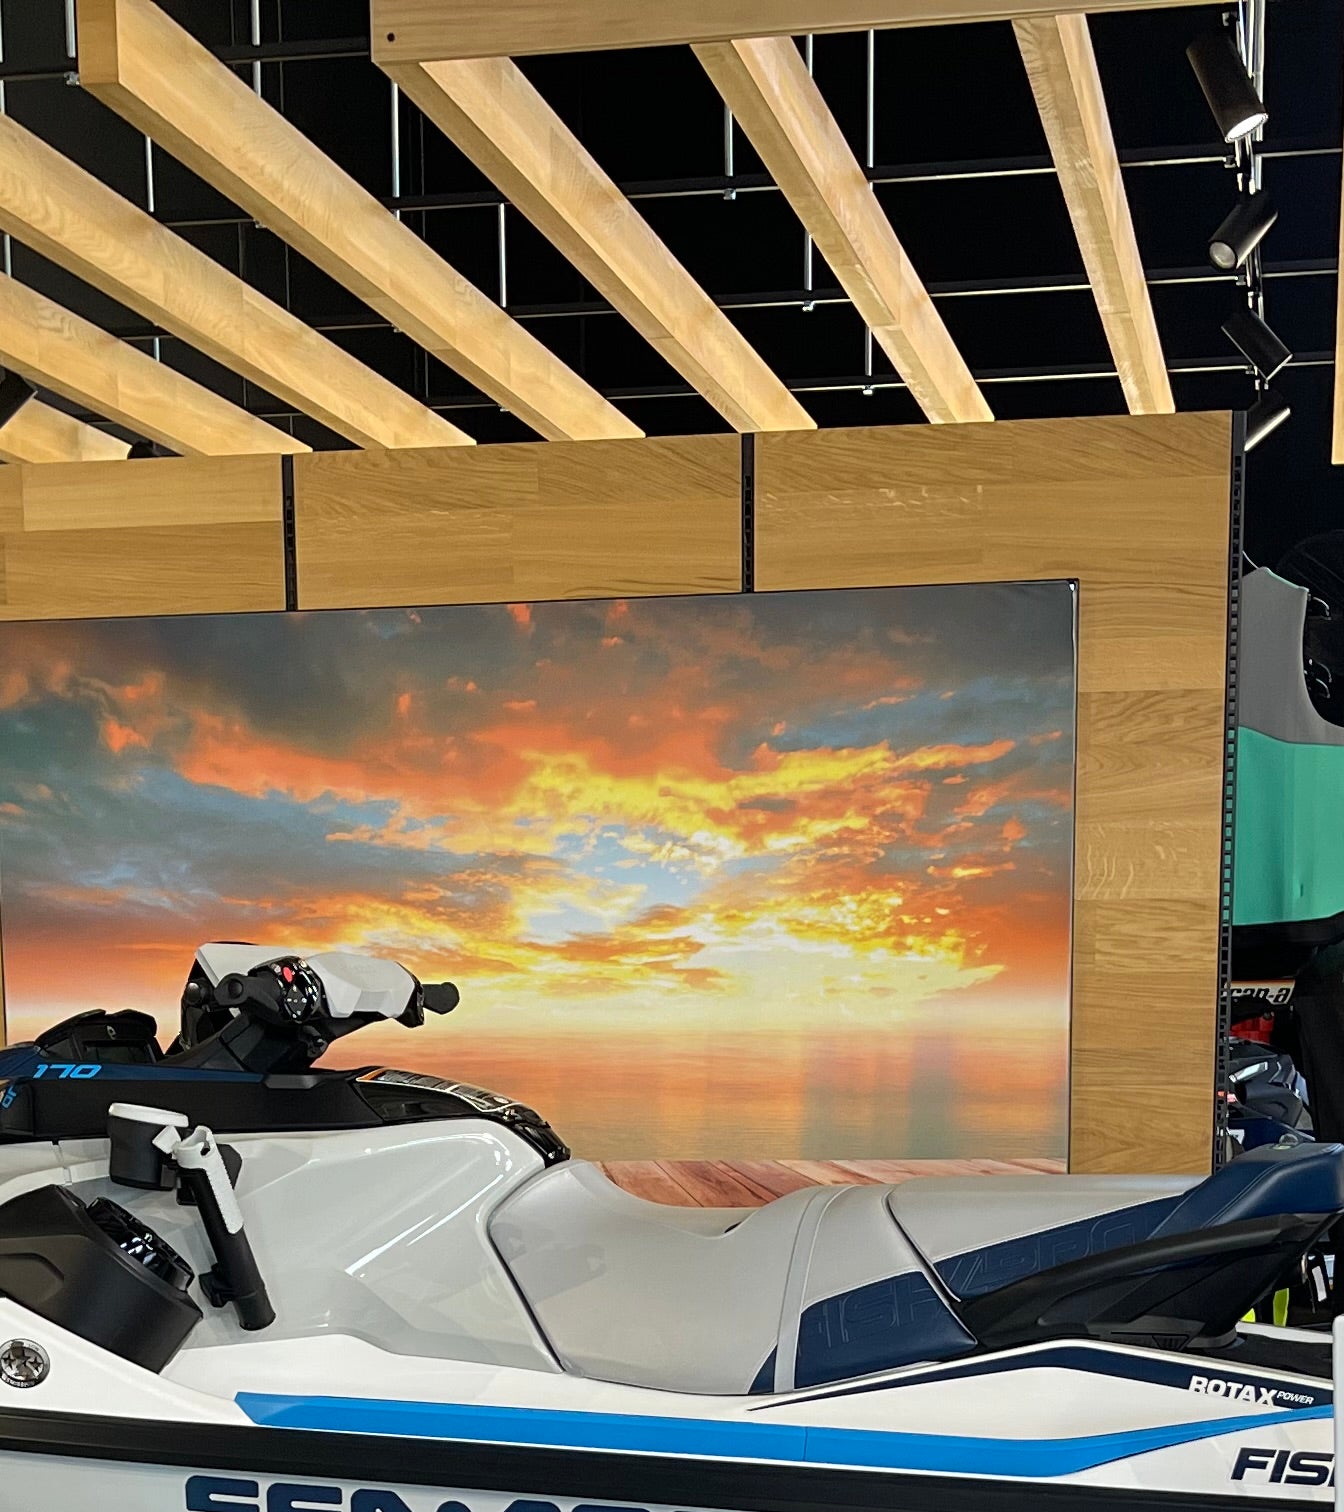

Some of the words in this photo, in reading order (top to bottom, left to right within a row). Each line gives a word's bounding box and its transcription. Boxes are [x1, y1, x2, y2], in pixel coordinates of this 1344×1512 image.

[33, 1064, 102, 1080] 170
[1189, 1375, 1277, 1407] ROTAX
[1276, 1391, 1315, 1406] POWER
